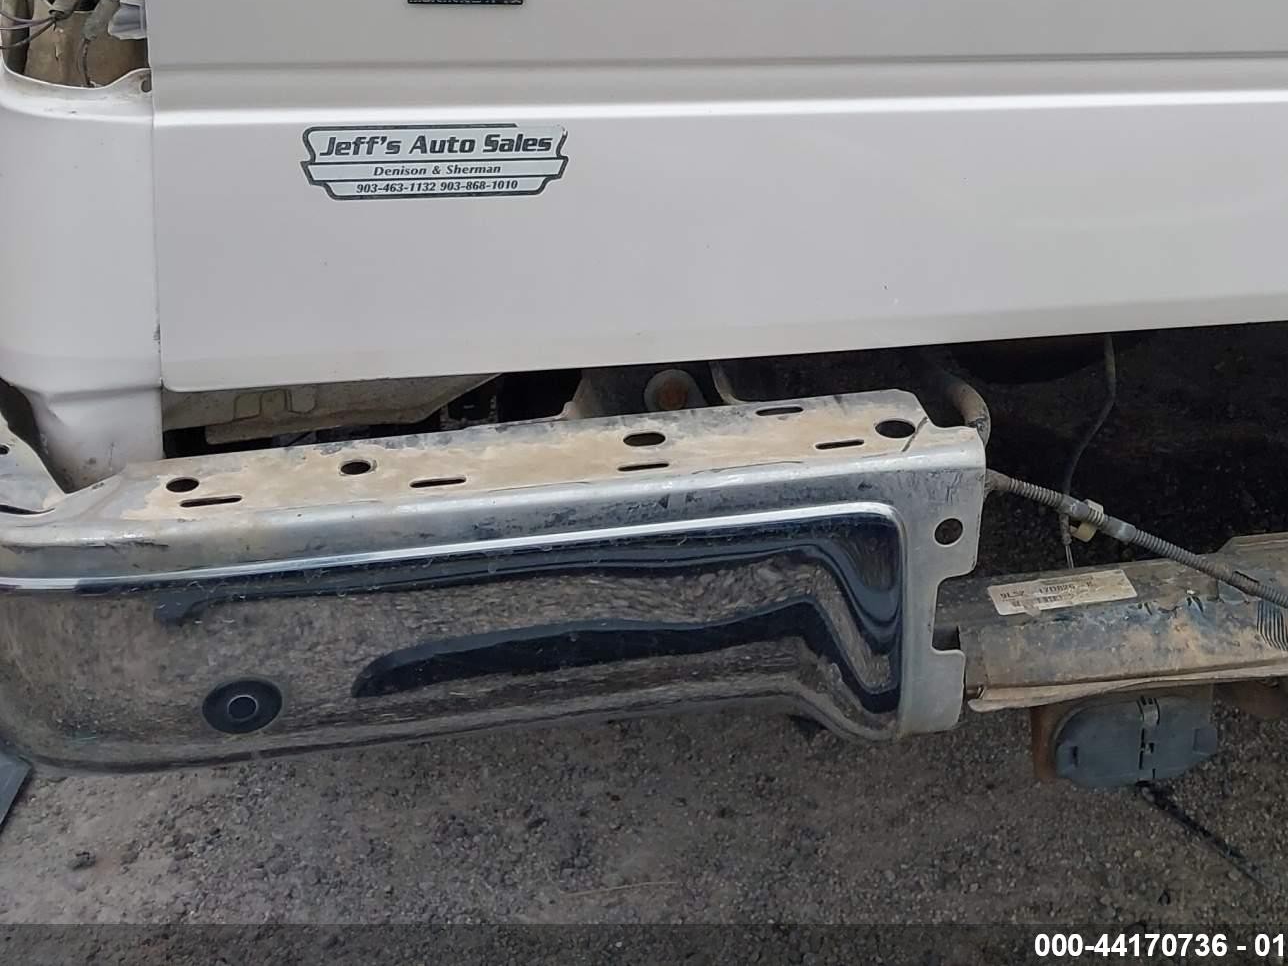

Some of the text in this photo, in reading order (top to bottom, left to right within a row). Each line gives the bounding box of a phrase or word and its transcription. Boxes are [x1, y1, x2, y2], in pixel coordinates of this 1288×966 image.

[320, 133, 553, 156] Jeff's Auto Sales
[373, 163, 501, 176] Denison & Sherman
[356, 179, 518, 194] 903-463-1132 903-868-1010
